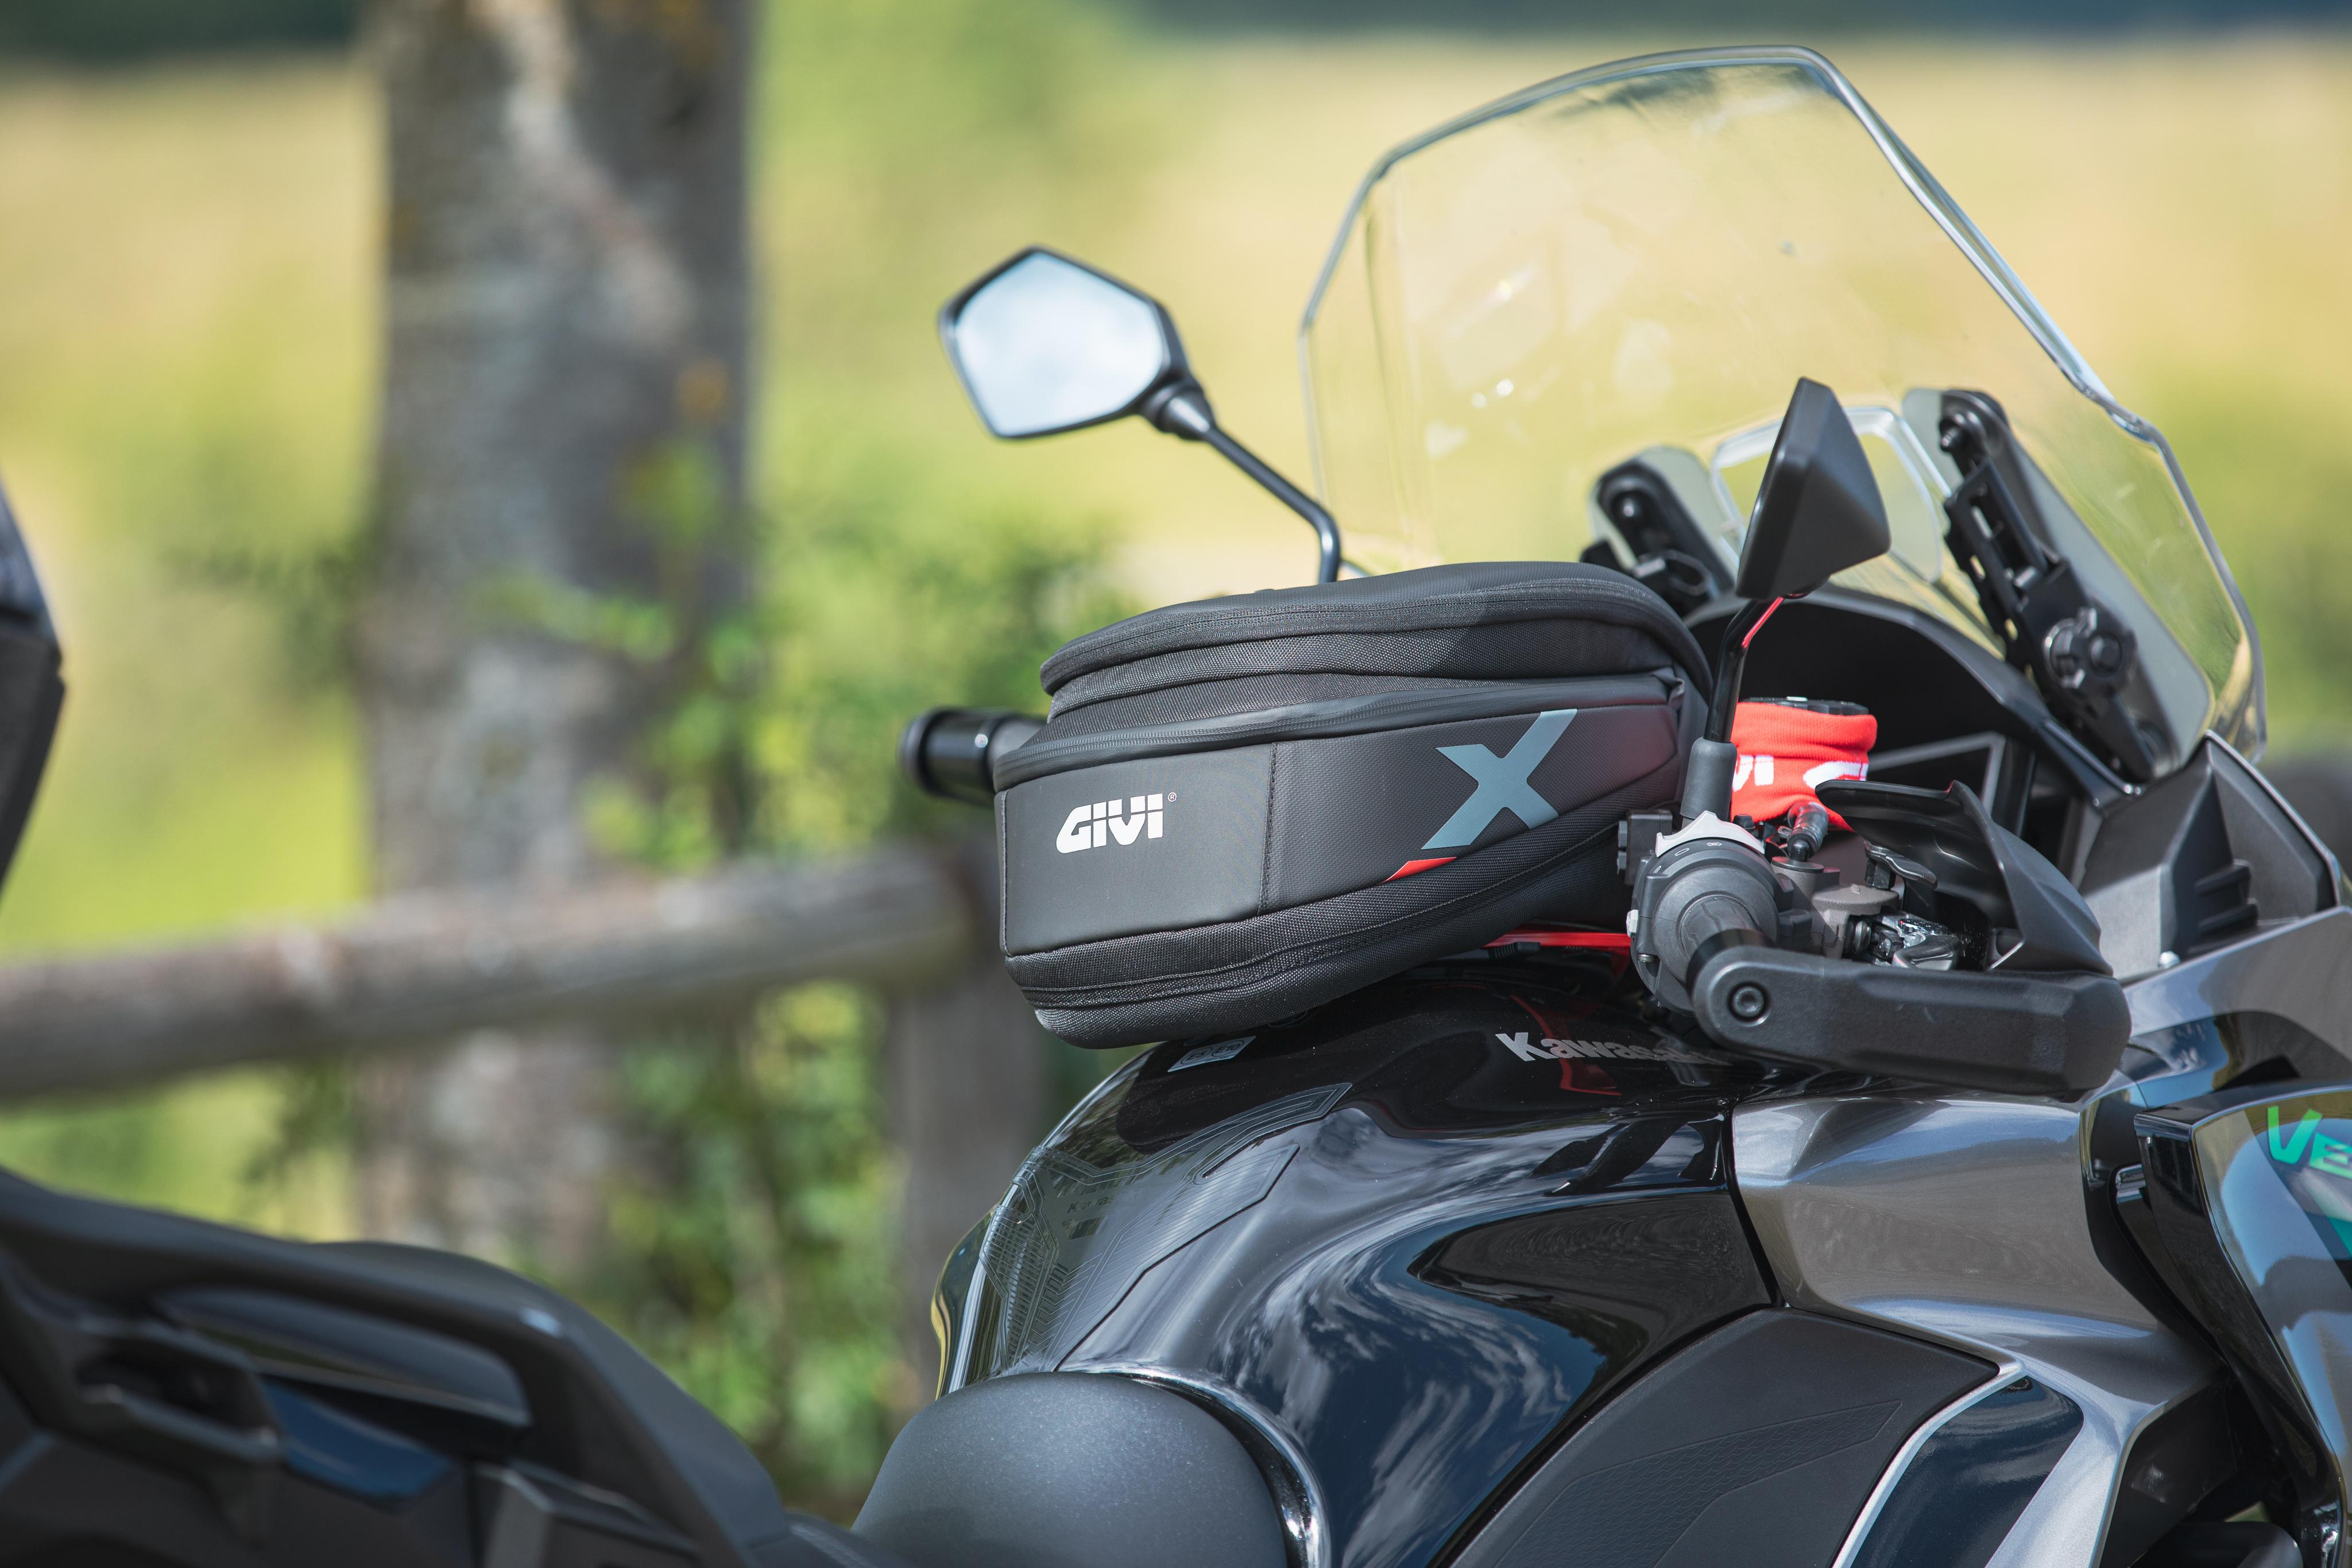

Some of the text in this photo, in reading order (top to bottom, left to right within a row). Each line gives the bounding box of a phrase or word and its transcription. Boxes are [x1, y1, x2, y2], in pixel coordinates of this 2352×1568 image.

[1421, 708, 1578, 850] X
[1056, 793, 1163, 854] GIVI
[1186, 1050, 1208, 1061] E5
[1214, 1043, 1241, 1054] E10
